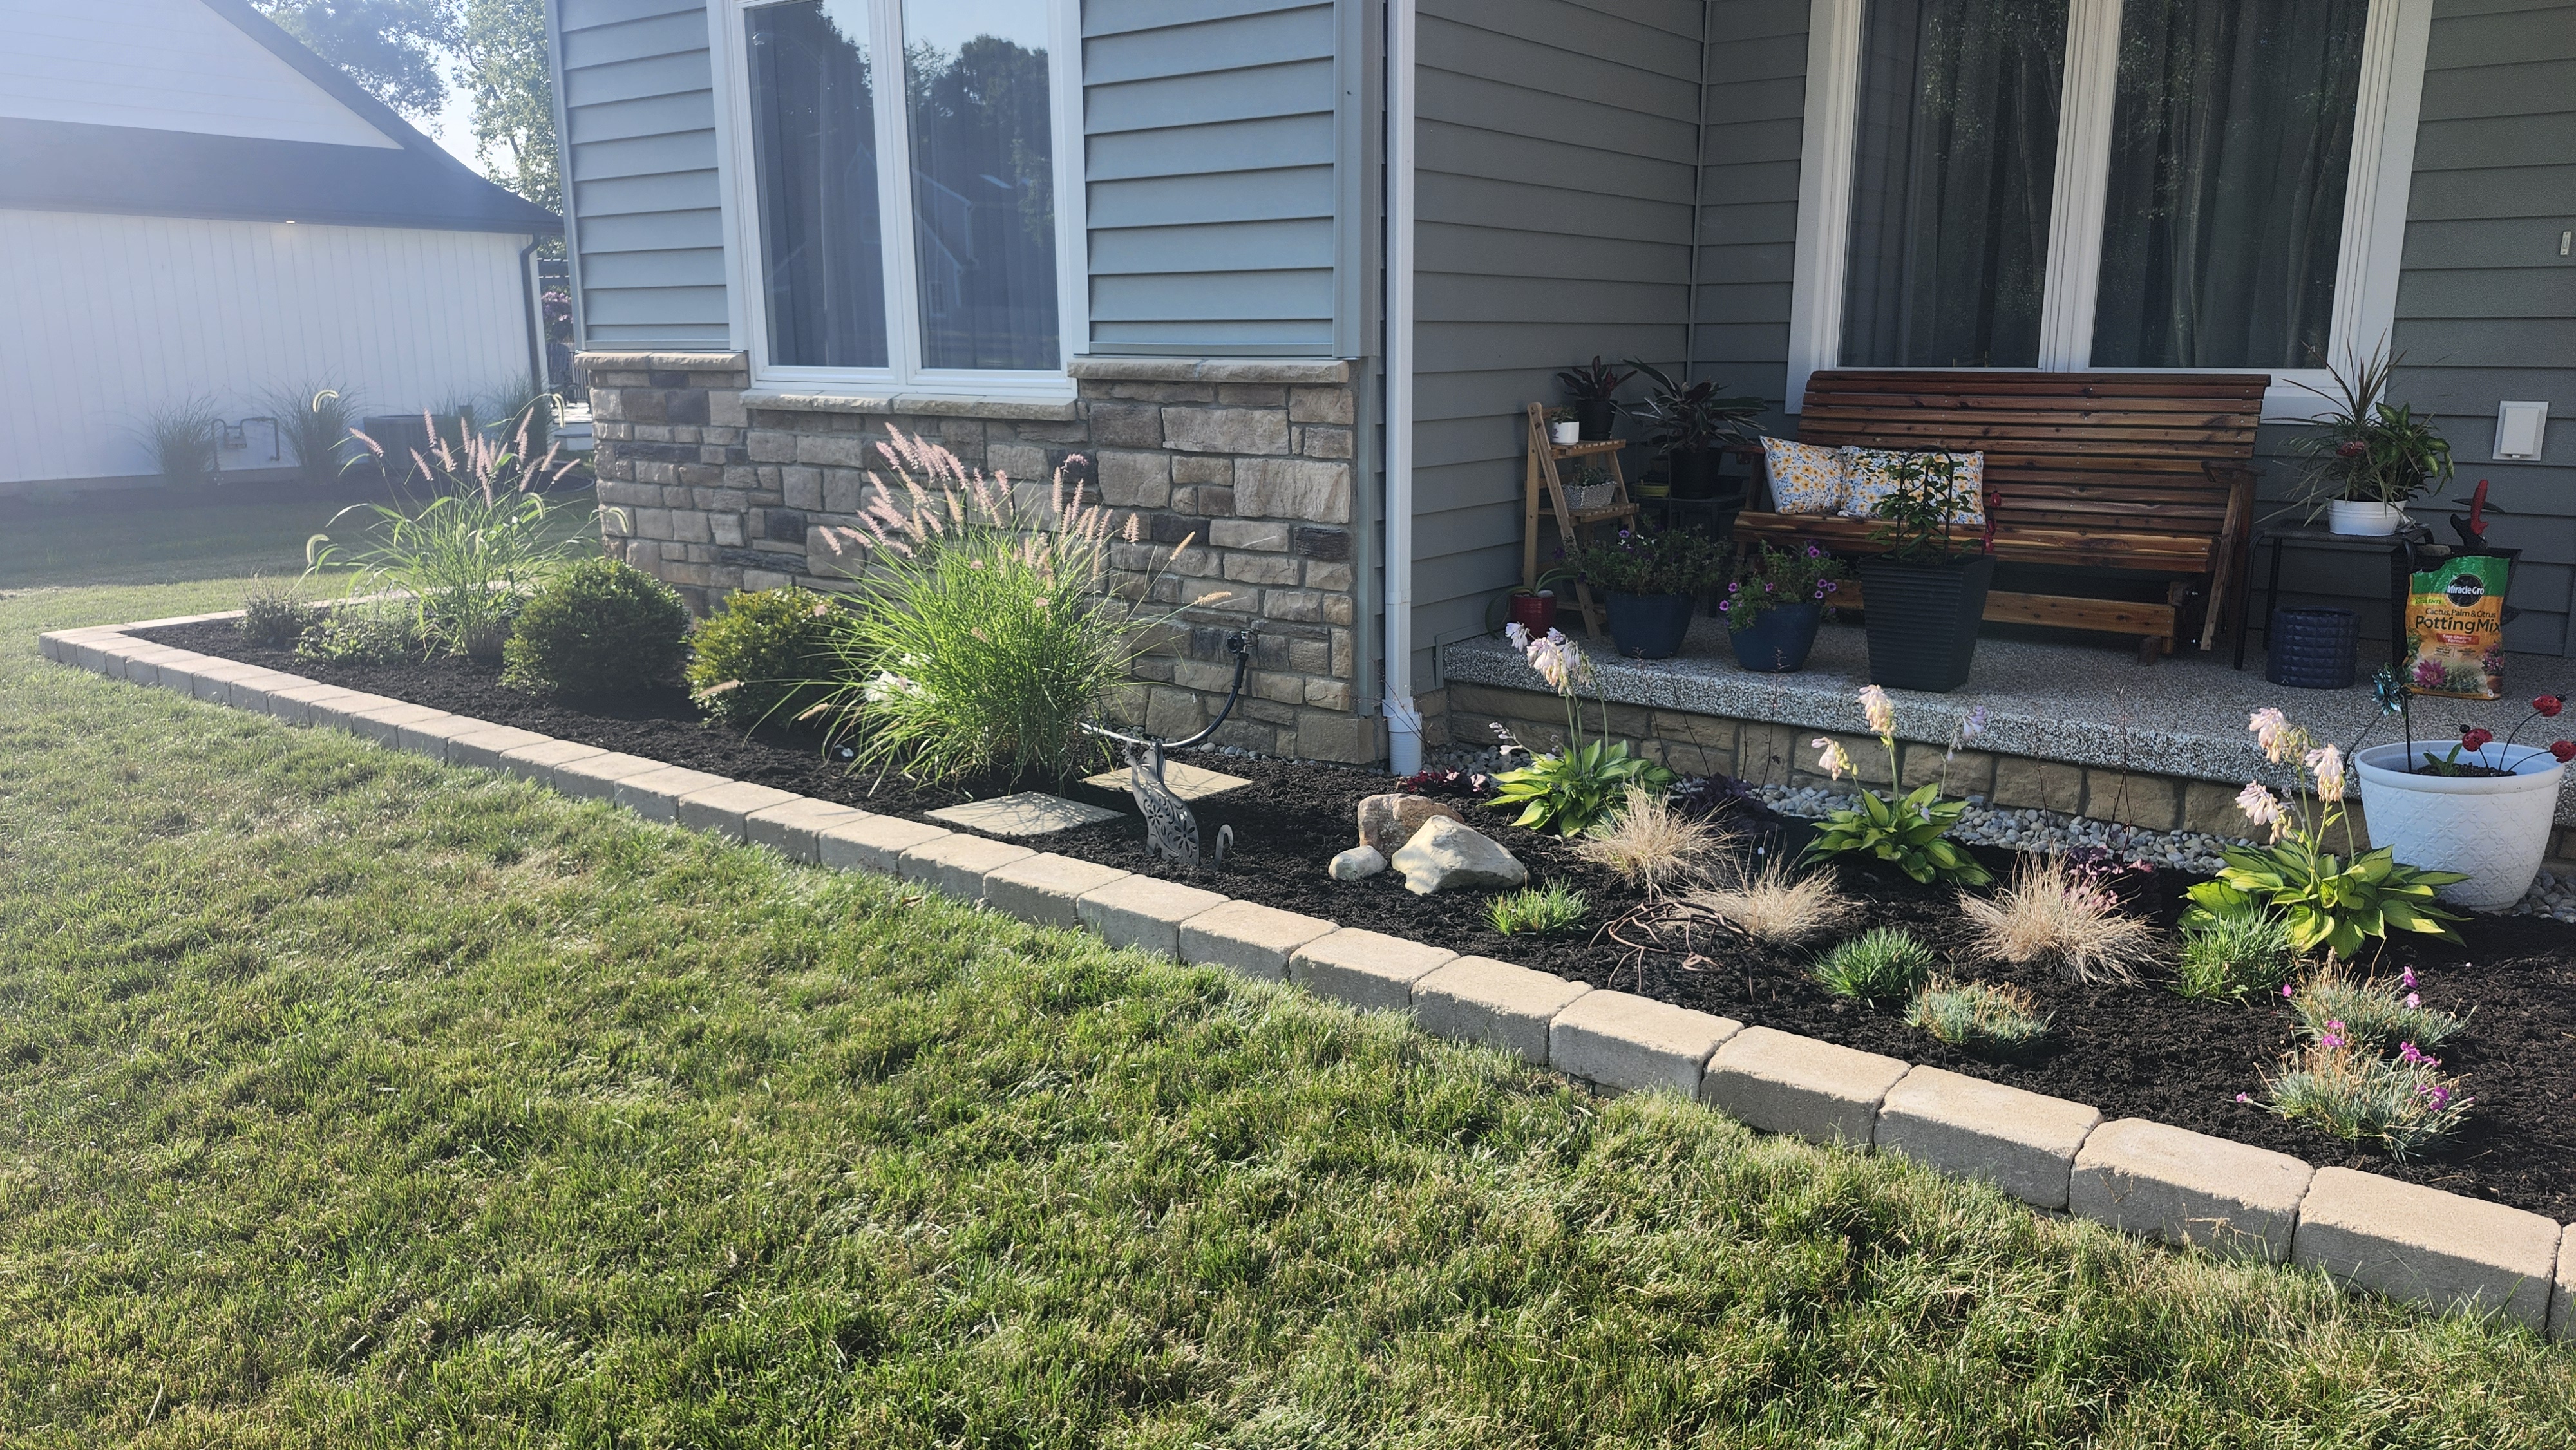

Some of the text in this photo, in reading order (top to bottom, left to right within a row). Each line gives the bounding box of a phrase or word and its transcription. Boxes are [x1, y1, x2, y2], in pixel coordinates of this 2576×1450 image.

[2425, 608, 2450, 616] Cactus,
[2416, 615, 2500, 634] Potting Mix
[2488, 689, 2494, 697] 8
